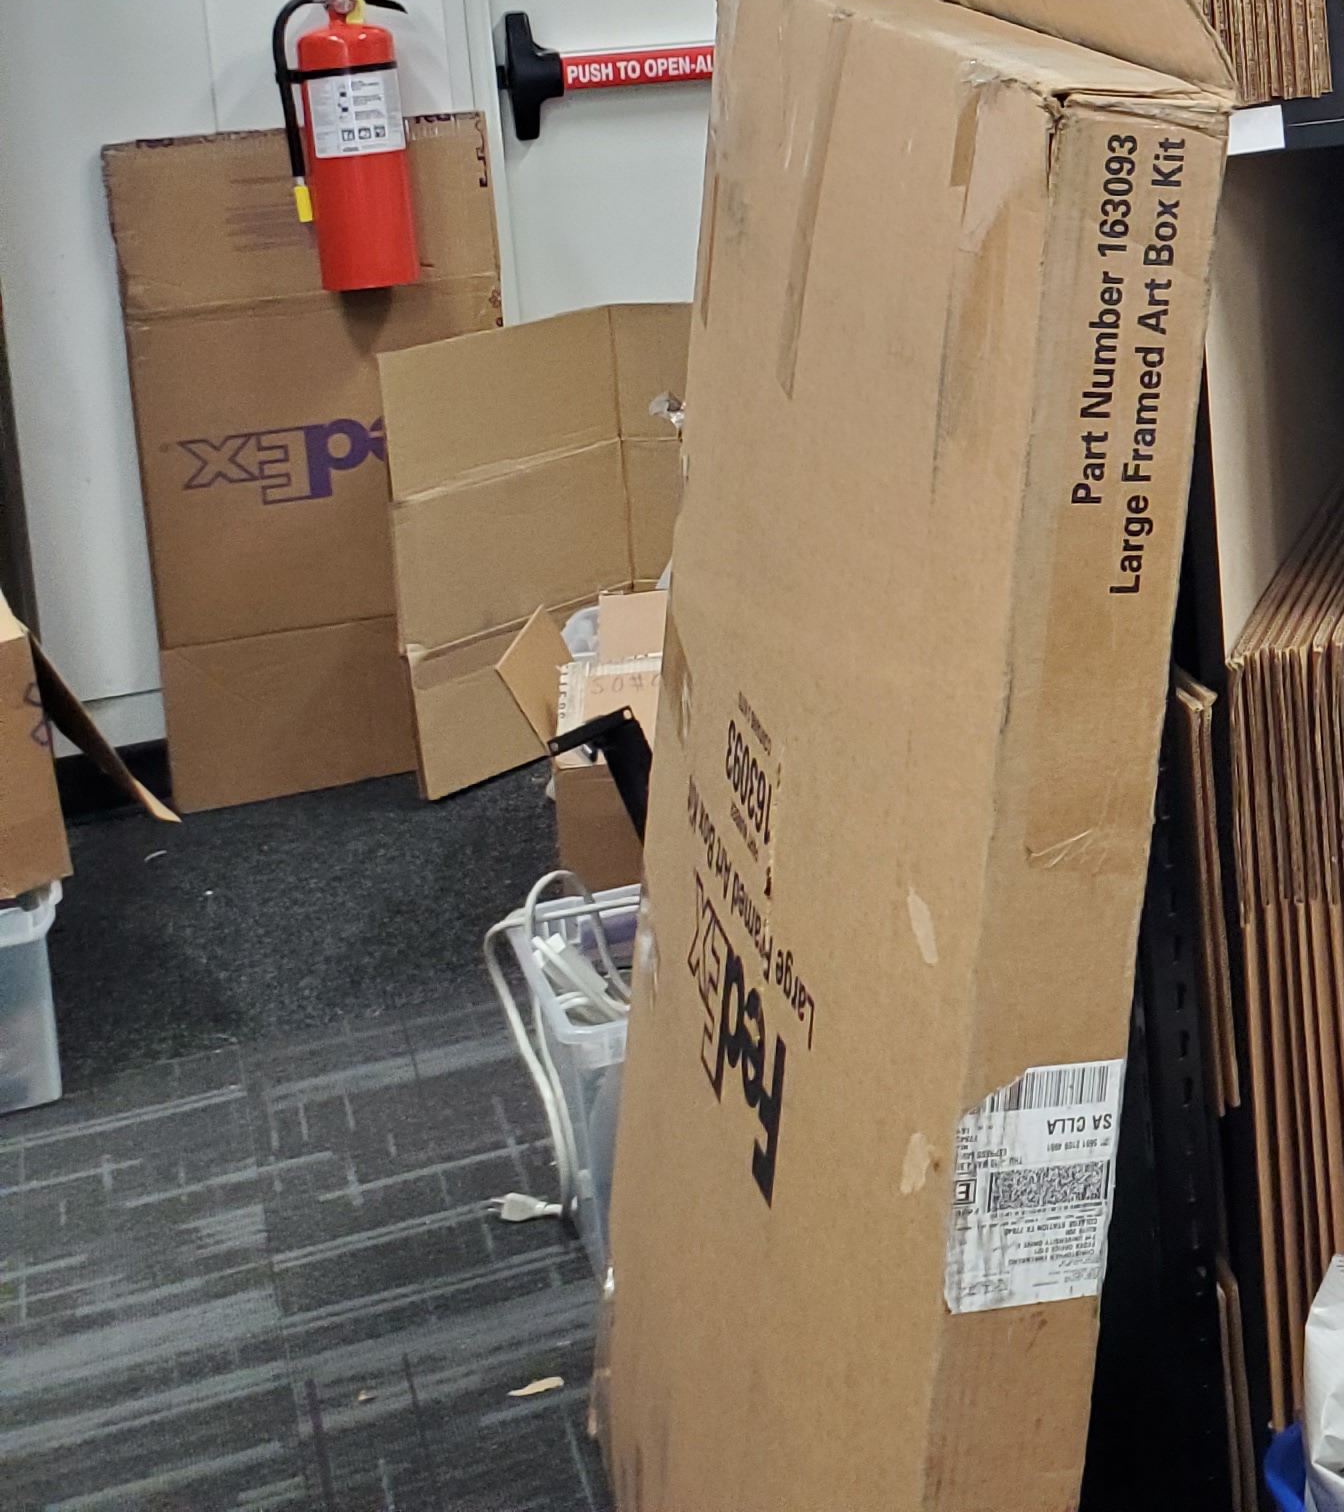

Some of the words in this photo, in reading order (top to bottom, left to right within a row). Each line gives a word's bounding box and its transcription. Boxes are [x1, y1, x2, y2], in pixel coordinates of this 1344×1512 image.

[566, 62, 614, 85] PUSH
[616, 60, 641, 80] TO
[1097, 134, 1138, 258] 163093
[1151, 137, 1187, 188] Kit
[1143, 198, 1181, 267] Box
[1136, 277, 1174, 336] Art
[1080, 270, 1125, 420] Number
[1121, 346, 1165, 483] Framed
[1071, 430, 1109, 505] Part
[1109, 493, 1155, 595] Large
[726, 719, 773, 846] 163093
[698, 808, 716, 869] Box
[713, 843, 732, 901] Art
[730, 869, 775, 984] Framed
[777, 948, 816, 1051] Large
[687, 867, 787, 1210] FedEx
[1047, 1116, 1086, 1136] CLLA
[1092, 1113, 1112, 1131] SA
[1037, 1221, 1066, 1231] STATION
